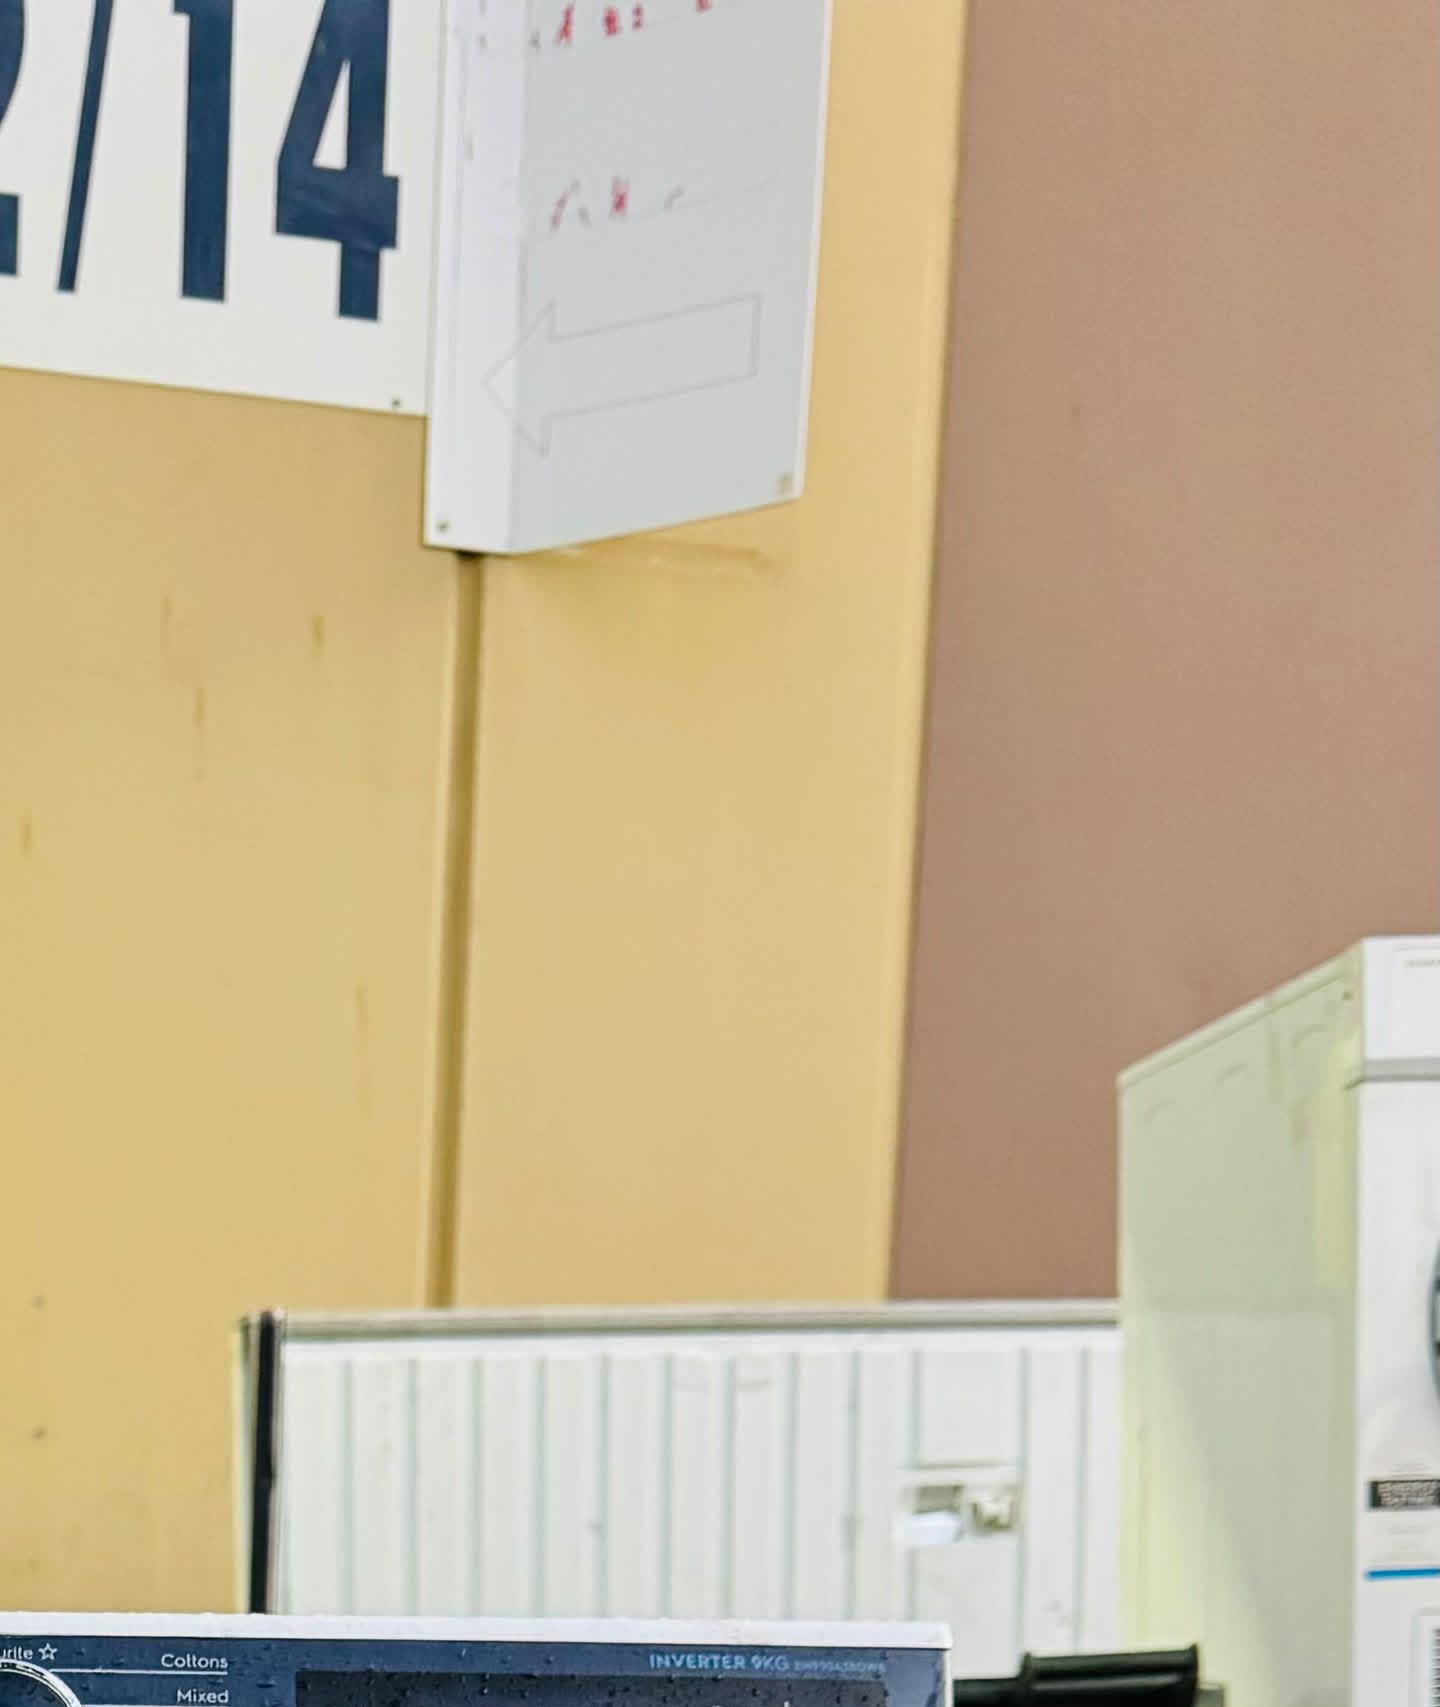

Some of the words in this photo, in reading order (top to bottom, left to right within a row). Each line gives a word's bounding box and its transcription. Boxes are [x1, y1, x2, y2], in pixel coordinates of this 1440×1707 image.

[161, 1654, 228, 1669] Cottons
[649, 1654, 747, 1669] INVERTER
[752, 1656, 790, 1670] 9KG
[177, 1688, 228, 1703] Mixed
